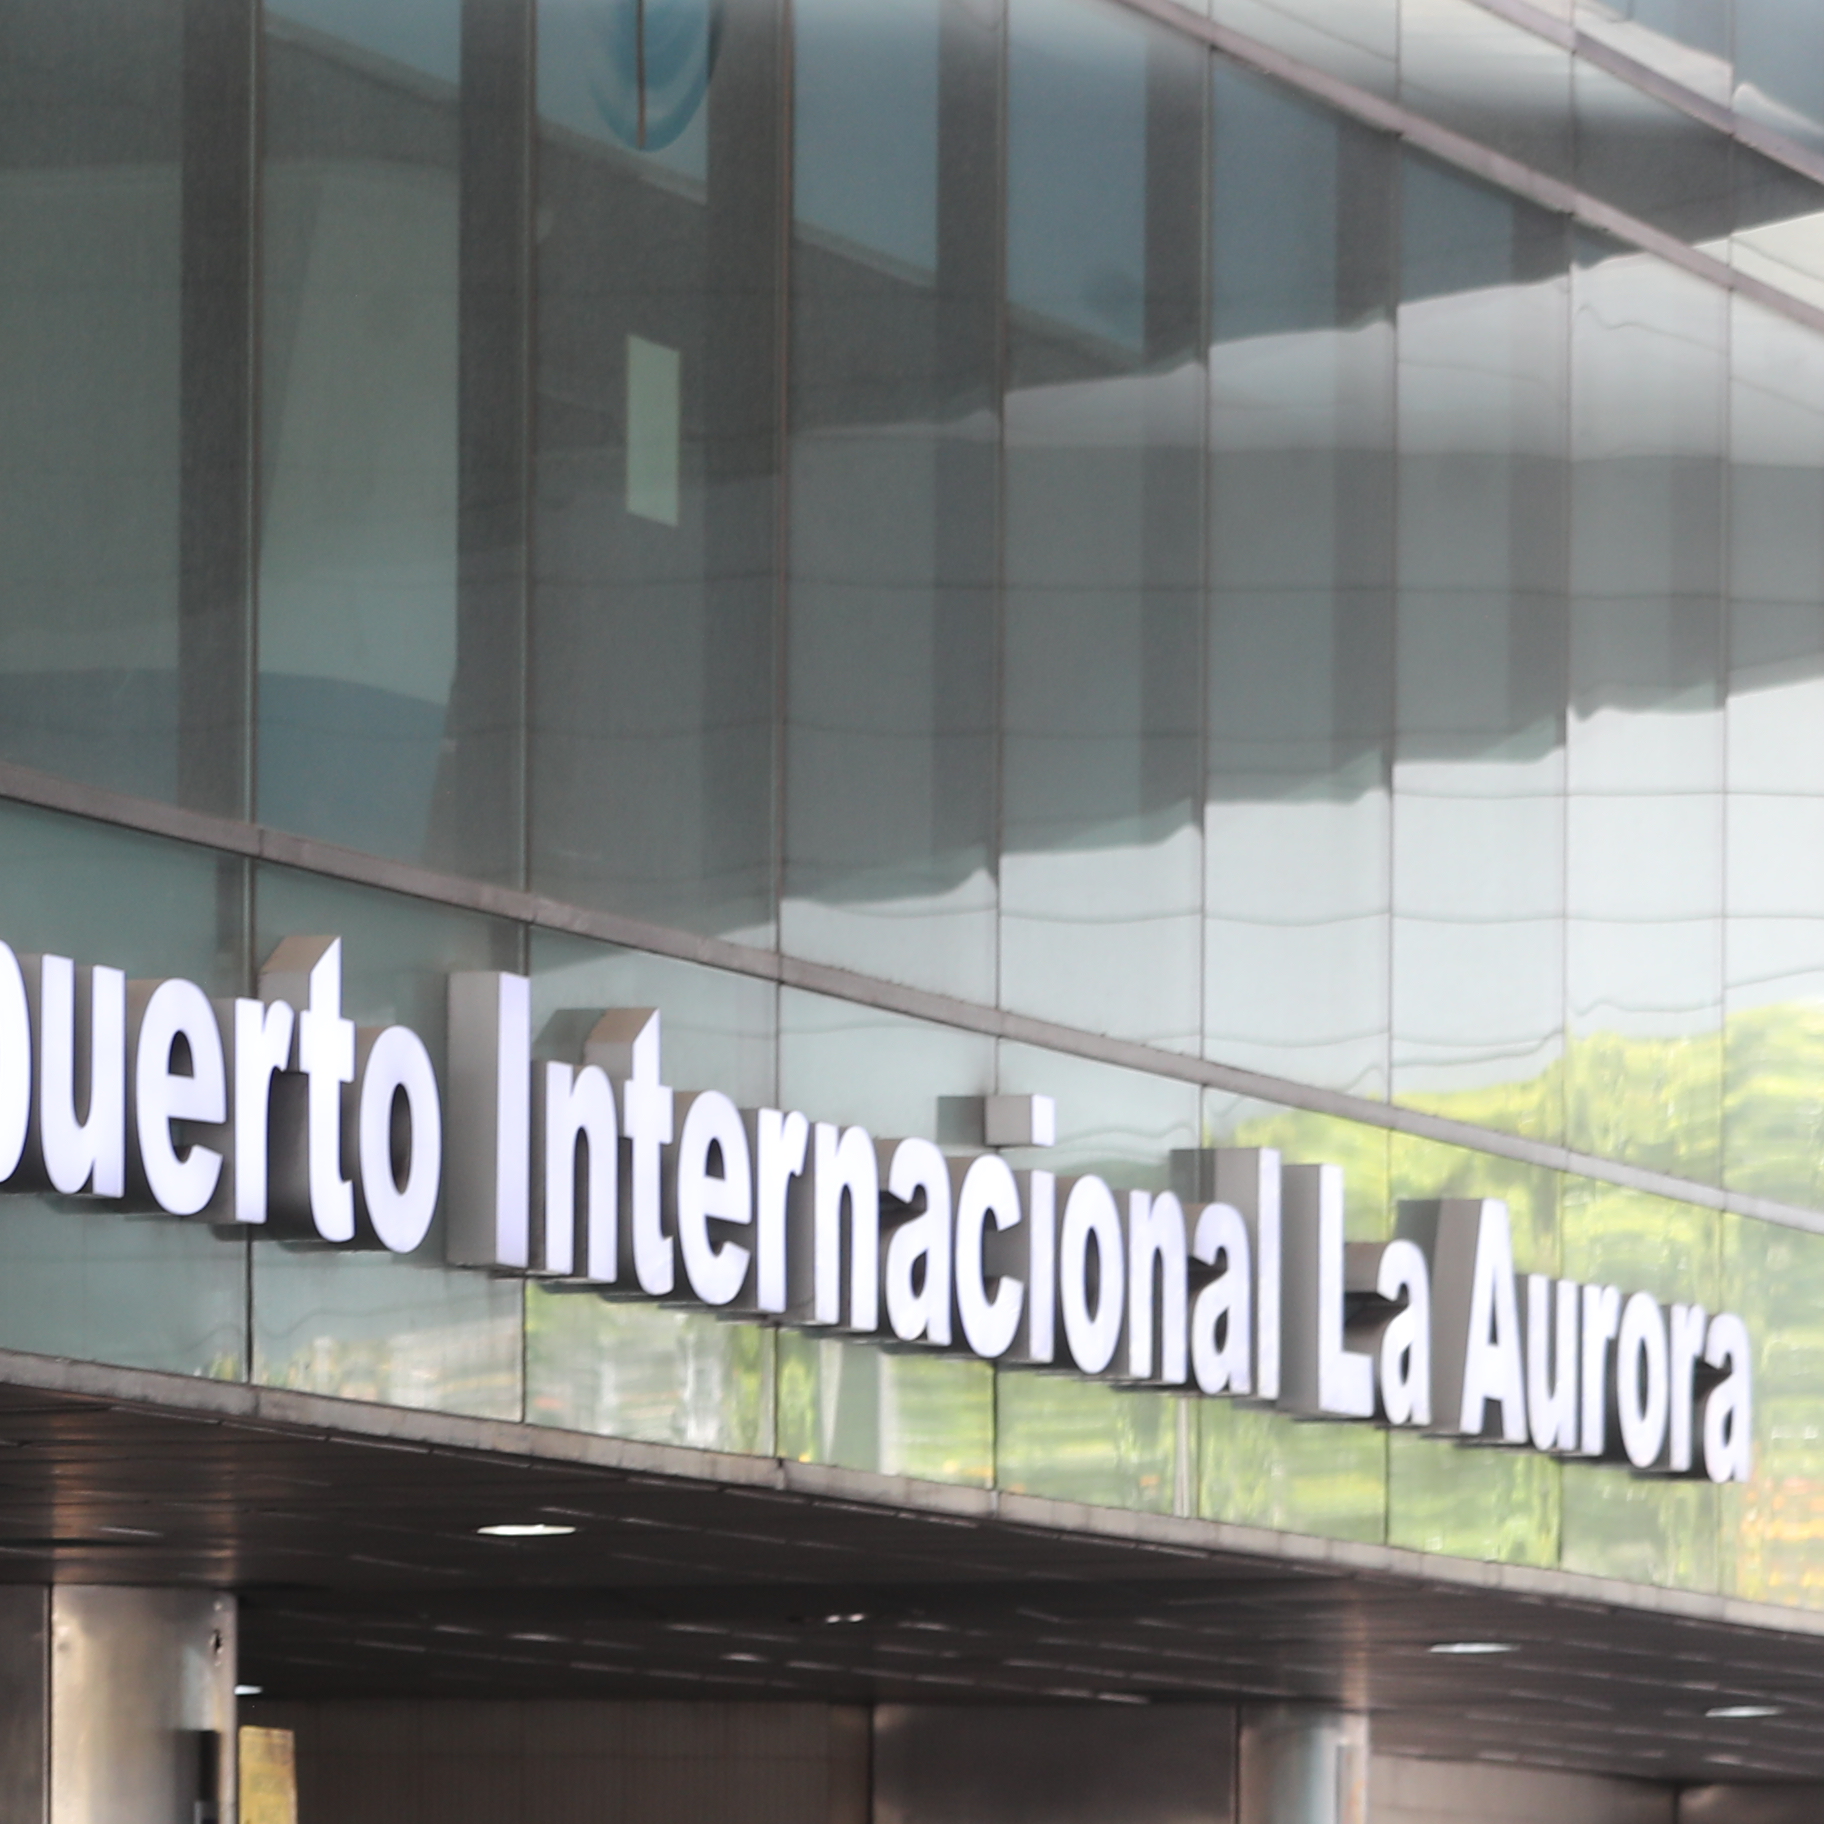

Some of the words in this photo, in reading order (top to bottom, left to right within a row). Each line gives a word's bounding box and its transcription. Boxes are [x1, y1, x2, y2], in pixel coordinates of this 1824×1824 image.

[497, 971, 1280, 1399] Internacional
[1318, 1164, 1432, 1428] La
[1458, 1201, 1751, 1482] Aurora
